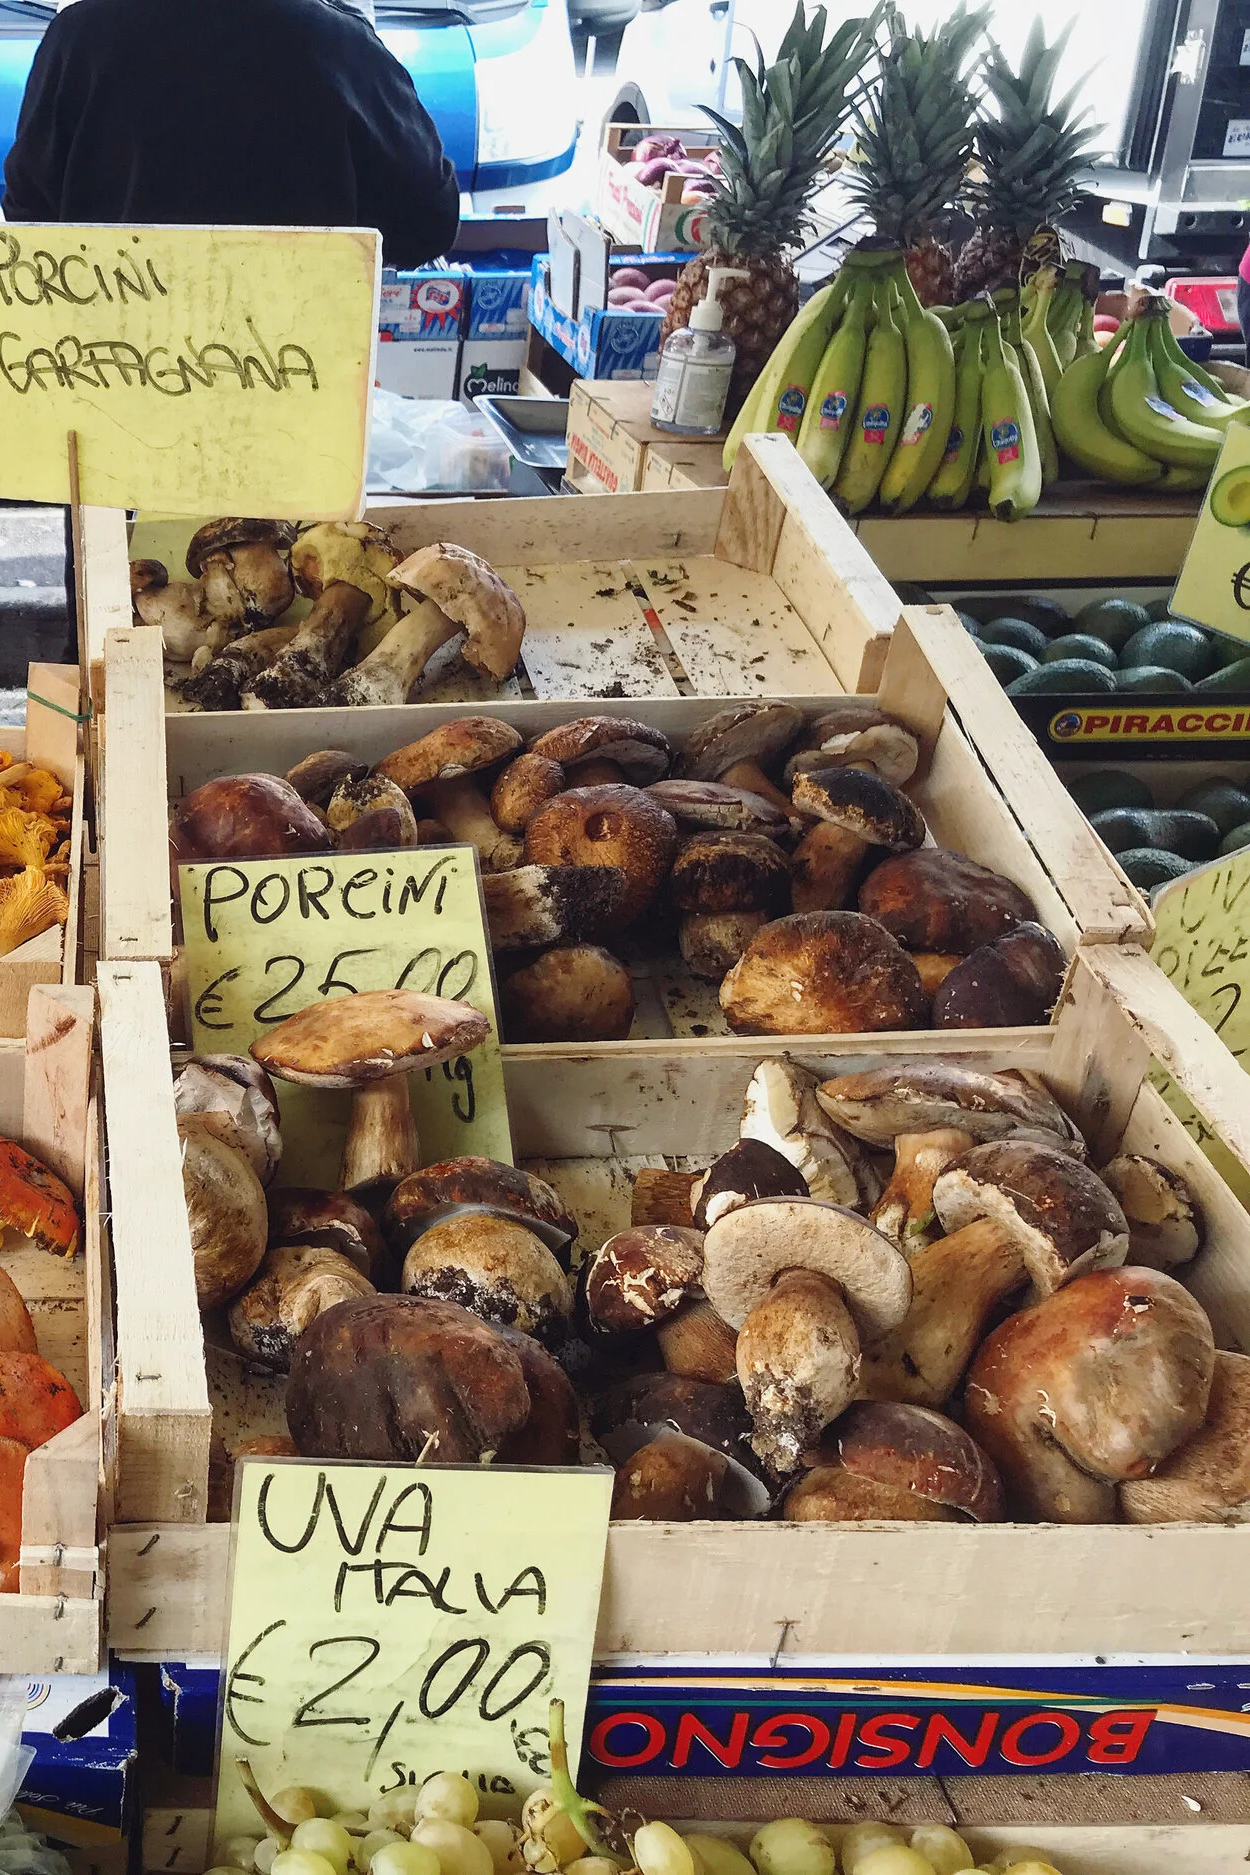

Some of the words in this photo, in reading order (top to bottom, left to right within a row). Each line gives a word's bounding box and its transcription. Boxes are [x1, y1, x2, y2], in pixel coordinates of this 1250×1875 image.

[1083, 713, 1250, 734] PIRACCI
[195, 965, 243, 1030] €
[253, 947, 478, 1025] 2500
[258, 1472, 433, 1555] UVA
[224, 1620, 287, 1747] €
[589, 1708, 1159, 1768] BONSIGNO
